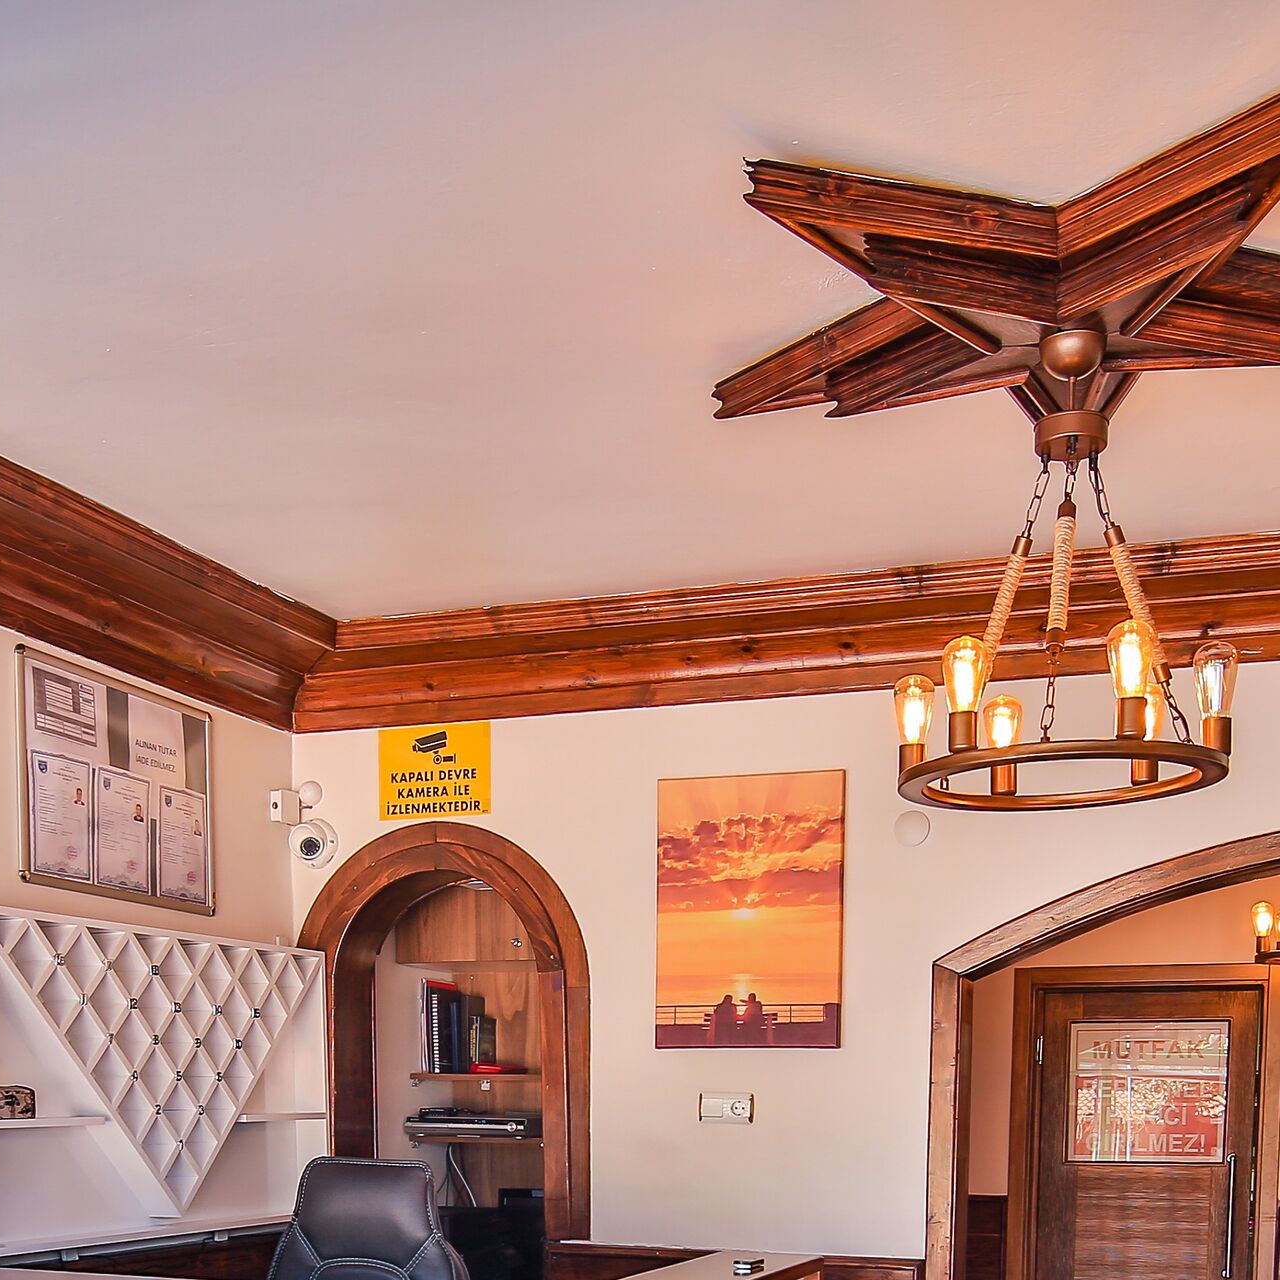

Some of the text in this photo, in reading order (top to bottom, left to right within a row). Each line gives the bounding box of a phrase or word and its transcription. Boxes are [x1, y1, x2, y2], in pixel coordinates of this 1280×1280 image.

[158, 744, 178, 757] TUTAR
[390, 768, 477, 783] KAPALI DEVRE
[397, 781, 470, 799] KAMERA İLE
[386, 797, 481, 815] İZLENMEKTEDİR
[127, 998, 138, 1010] 12
[151, 1034, 160, 1046] 8
[194, 1037, 202, 1049] 9
[1093, 1040, 1205, 1060] MUTFAK
[129, 1070, 138, 1082] 4
[174, 1070, 183, 1082] 5
[215, 1071, 223, 1082] 6
[154, 1104, 162, 1115] 2
[198, 1104, 205, 1116] 3
[177, 1139, 184, 1152] 1
[1085, 1131, 1207, 1153] GİRLMEZ!
